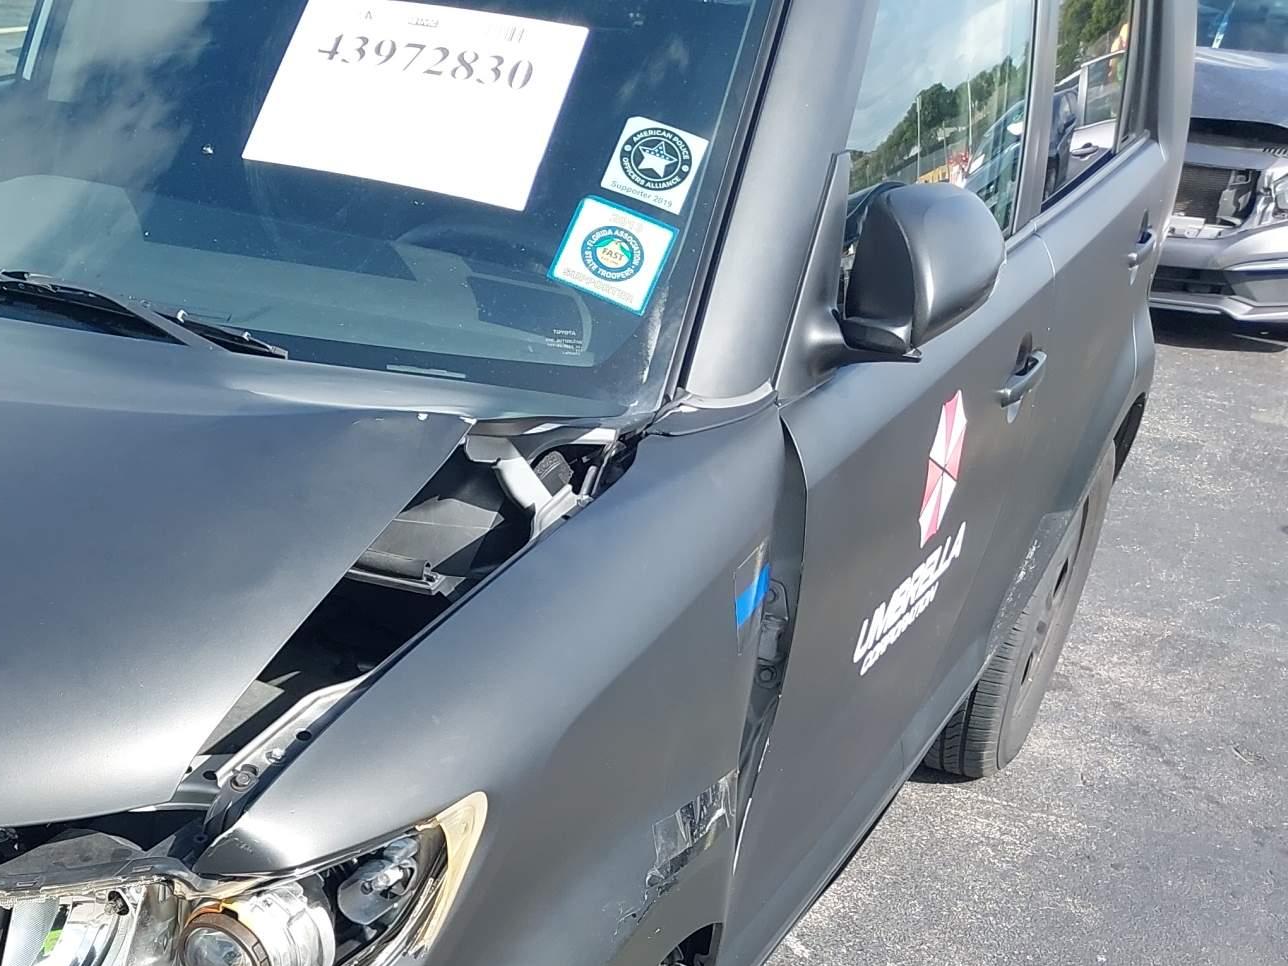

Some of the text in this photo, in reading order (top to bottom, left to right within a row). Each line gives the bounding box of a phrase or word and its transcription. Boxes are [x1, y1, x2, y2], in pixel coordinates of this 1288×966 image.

[317, 32, 534, 90] 43972830
[632, 129, 690, 160] AMERICAN POLICE
[622, 157, 680, 189] OFFICERS ALLIANCE
[610, 180, 673, 208] Supporter 2019
[586, 229, 641, 265] FLORIDA ASSOCIATION
[601, 247, 624, 261] FAST
[597, 267, 634, 280] TROOPERS
[853, 521, 966, 664] UMBRELLA
